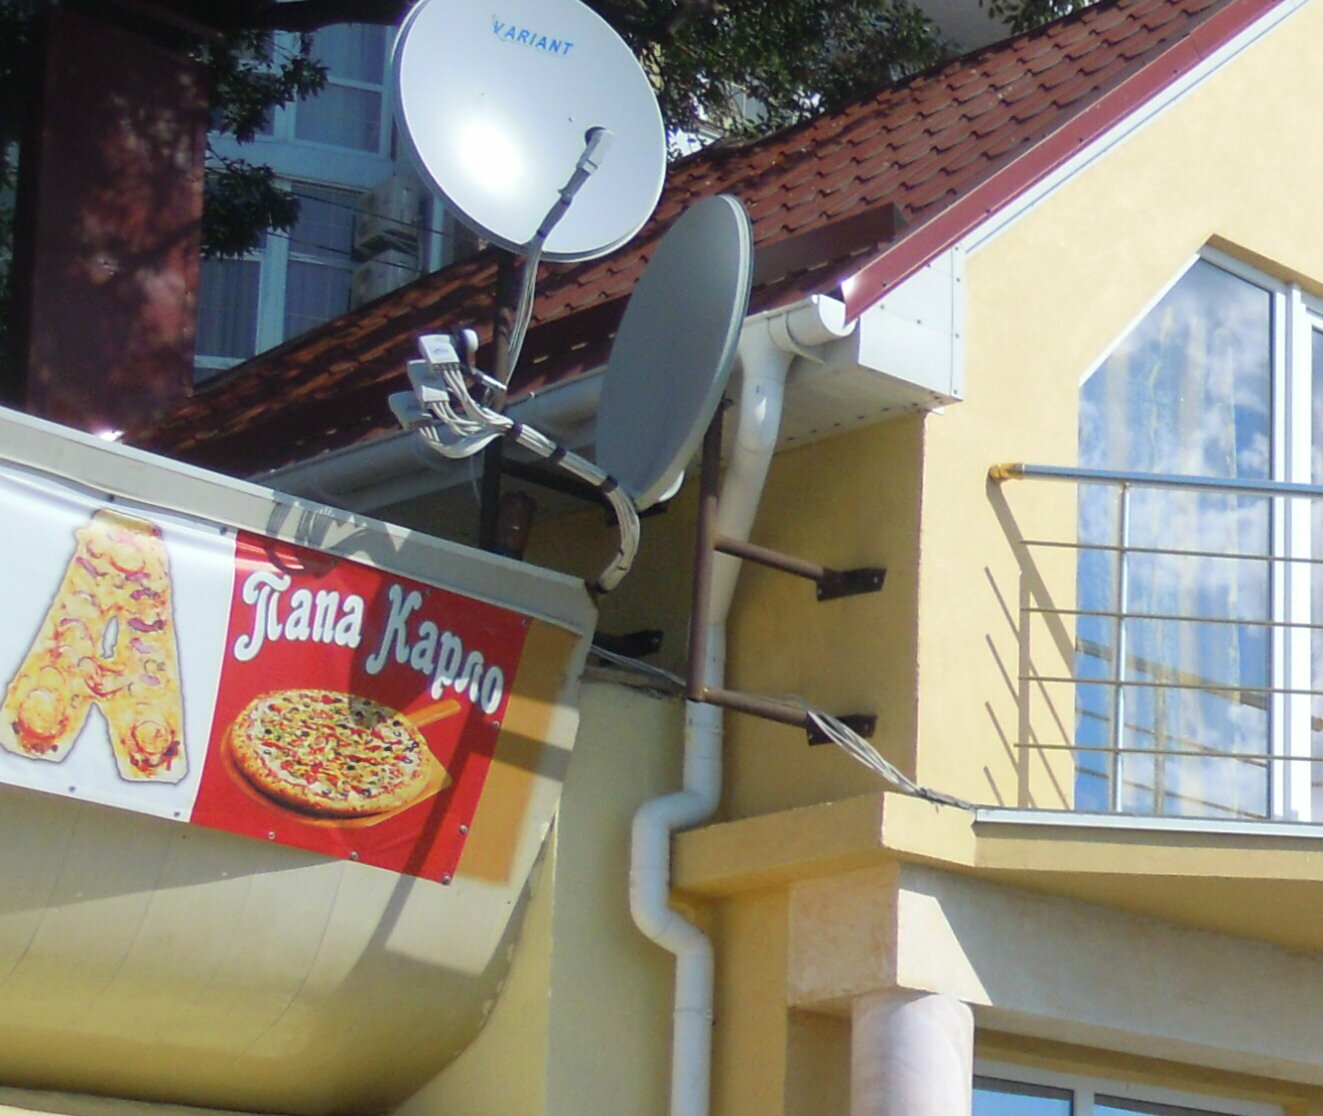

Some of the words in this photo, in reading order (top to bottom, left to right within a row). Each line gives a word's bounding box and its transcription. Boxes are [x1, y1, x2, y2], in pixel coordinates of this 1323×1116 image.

[492, 20, 574, 56] VARIANT
[233, 571, 365, 662] Папа
[365, 583, 505, 716] Карло
